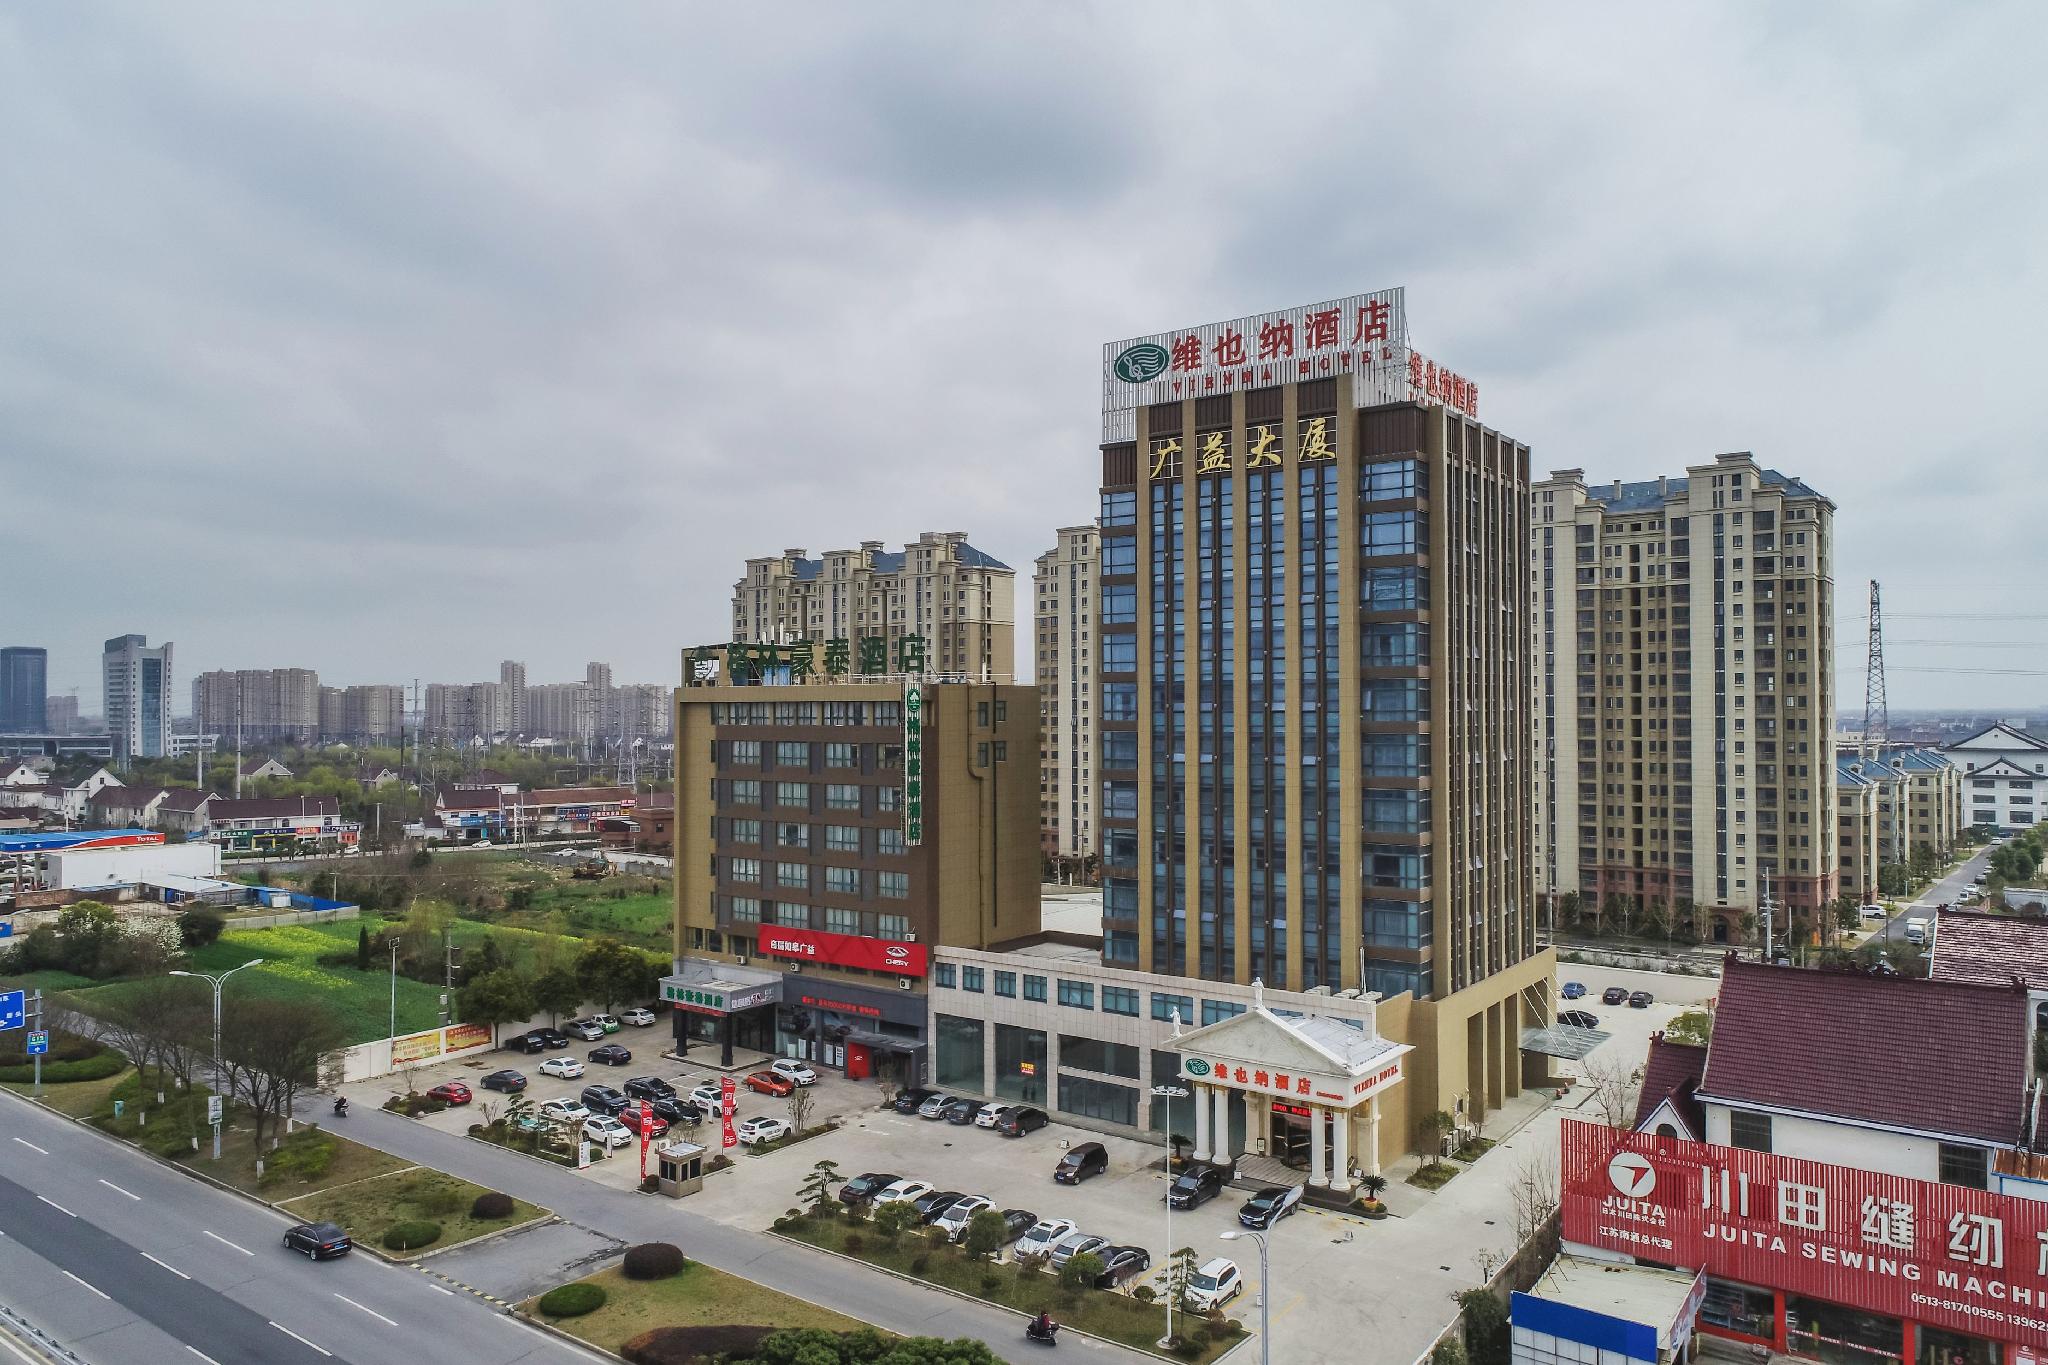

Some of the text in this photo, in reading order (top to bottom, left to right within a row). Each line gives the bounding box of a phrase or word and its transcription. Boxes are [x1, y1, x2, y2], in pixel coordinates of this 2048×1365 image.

[1171, 300, 1390, 372] 维也纳酒店
[1173, 347, 1393, 394] VIENNA HOTEL
[1150, 417, 1337, 479] 广益大厦
[1214, 1062, 1312, 1095] 维也纳酒店
[1602, 1195, 1666, 1218] JUITA
[1702, 1165, 2048, 1275] 川田缝纫
[1599, 1225, 1673, 1250] 江苏南通总代理
[1703, 1223, 2046, 1309] JUITA SEWING MACHI
[1911, 1292, 2004, 1322] 0513-81700555
